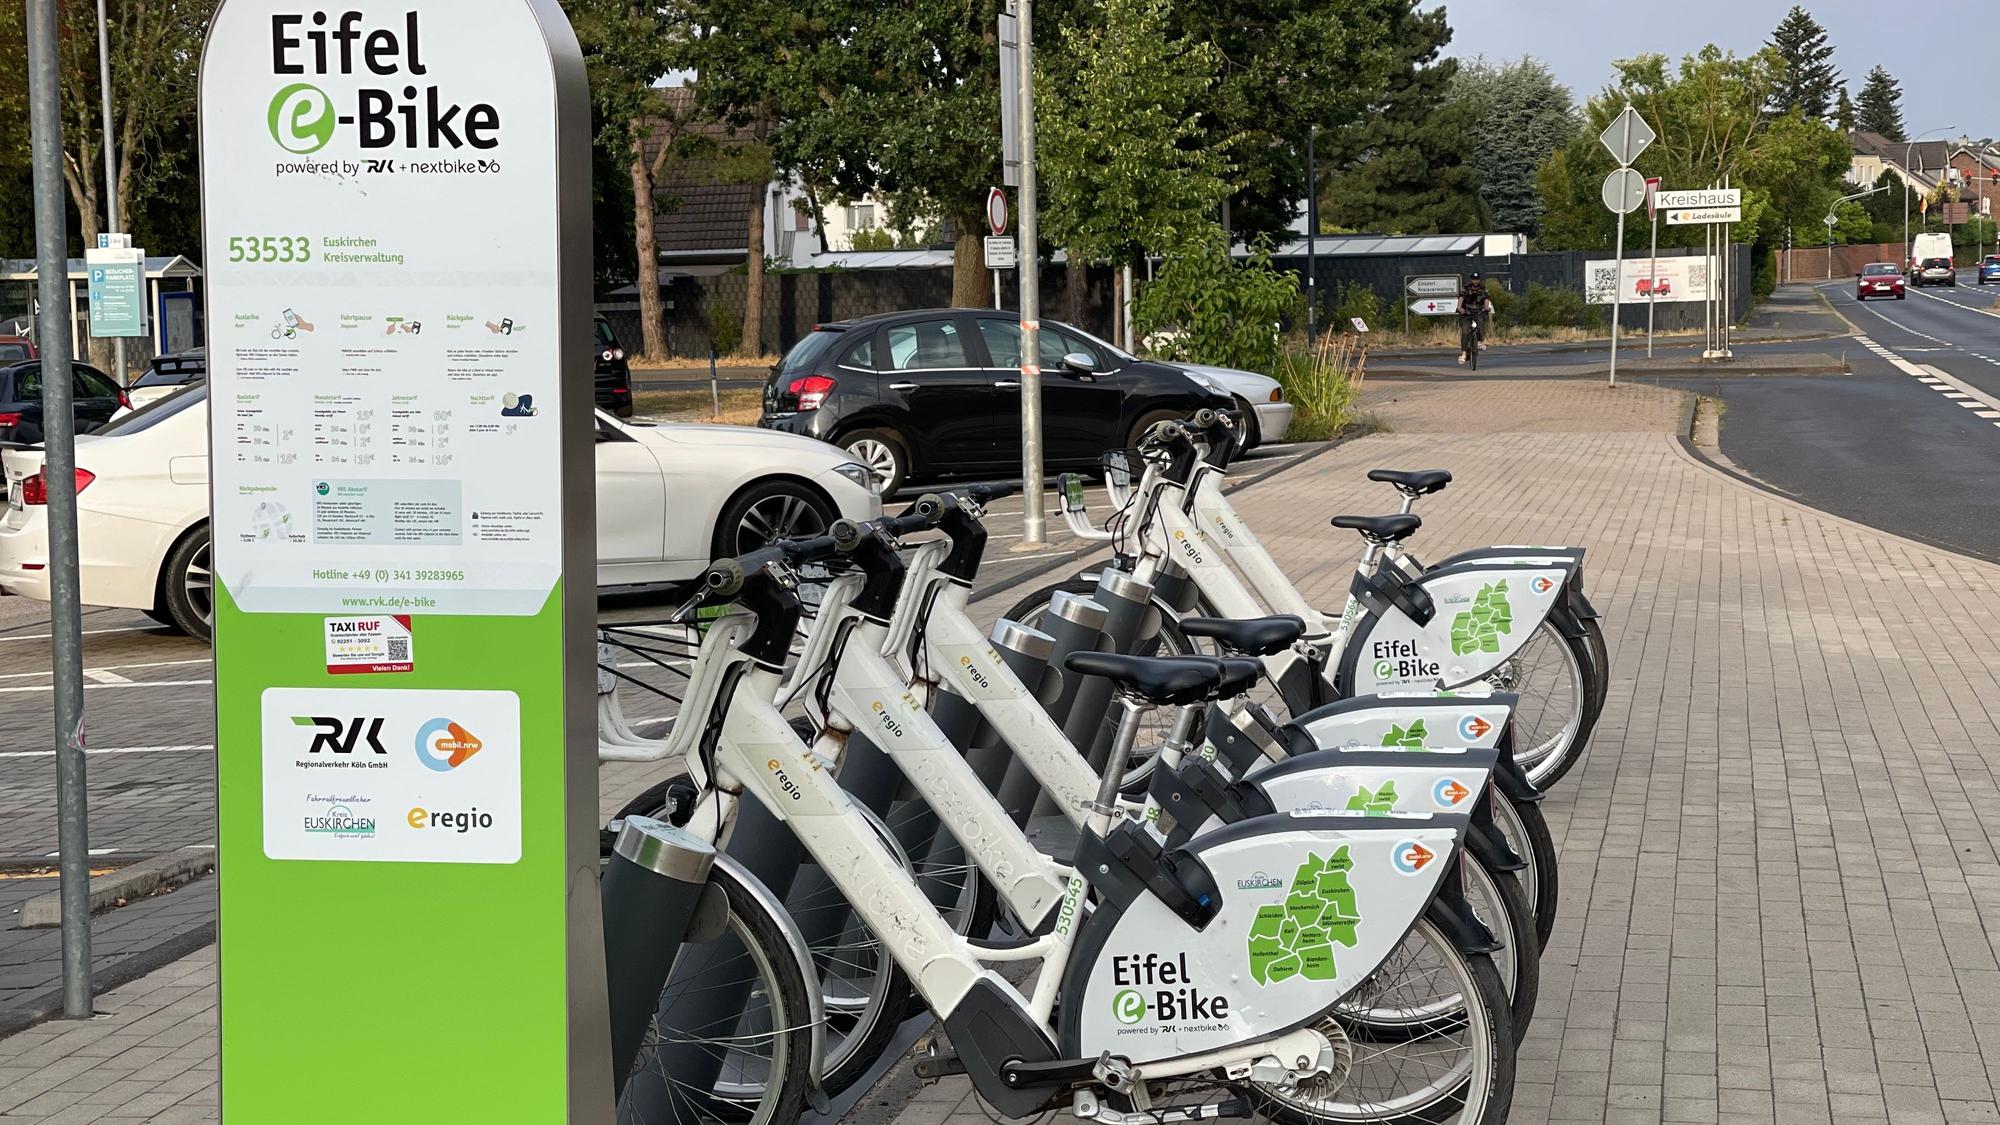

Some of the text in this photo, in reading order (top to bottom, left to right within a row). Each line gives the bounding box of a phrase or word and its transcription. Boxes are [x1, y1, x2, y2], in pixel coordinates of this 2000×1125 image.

[272, 10, 426, 75] Eifel
[268, 83, 500, 154] e-Bike
[276, 160, 338, 177] powered
[343, 160, 360, 177] by
[360, 160, 395, 174] RVK
[410, 159, 476, 174] nextbike
[1660, 192, 1734, 206] Kreishaus
[1692, 212, 1732, 220] Ladesäule
[229, 236, 376, 263] 53533 Euskirchen
[324, 252, 404, 264] Kreisverwaltung
[1174, 530, 1202, 564] eregio
[312, 570, 464, 582] Hotline +49 (0) 341 39283965
[342, 596, 436, 608] www.rvk.de/e-bike
[330, 621, 380, 632] TAXI RUF
[1374, 638, 1418, 659] Eifel
[960, 656, 988, 688] eregio
[1373, 659, 1440, 680] e-Bike
[872, 700, 903, 738] eregio
[289, 716, 388, 754] RVK
[440, 740, 478, 749] mobil.nrw
[296, 760, 388, 769] Regionalverkehr Köln GmbH
[768, 759, 801, 800] eregio
[306, 794, 372, 805] Fahrradfreundlicher
[304, 817, 375, 830] EUSKIRCHEN
[407, 807, 493, 833] eregio
[1237, 878, 1282, 887] EUSKIRCHEN
[1056, 878, 1082, 936] 530545
[1112, 952, 1190, 986] Eifel
[1112, 989, 1229, 1024] e-Bike
[1117, 1026, 1147, 1036] powered
[1150, 1026, 1158, 1034] by
[1184, 1024, 1216, 1032] nextbike
